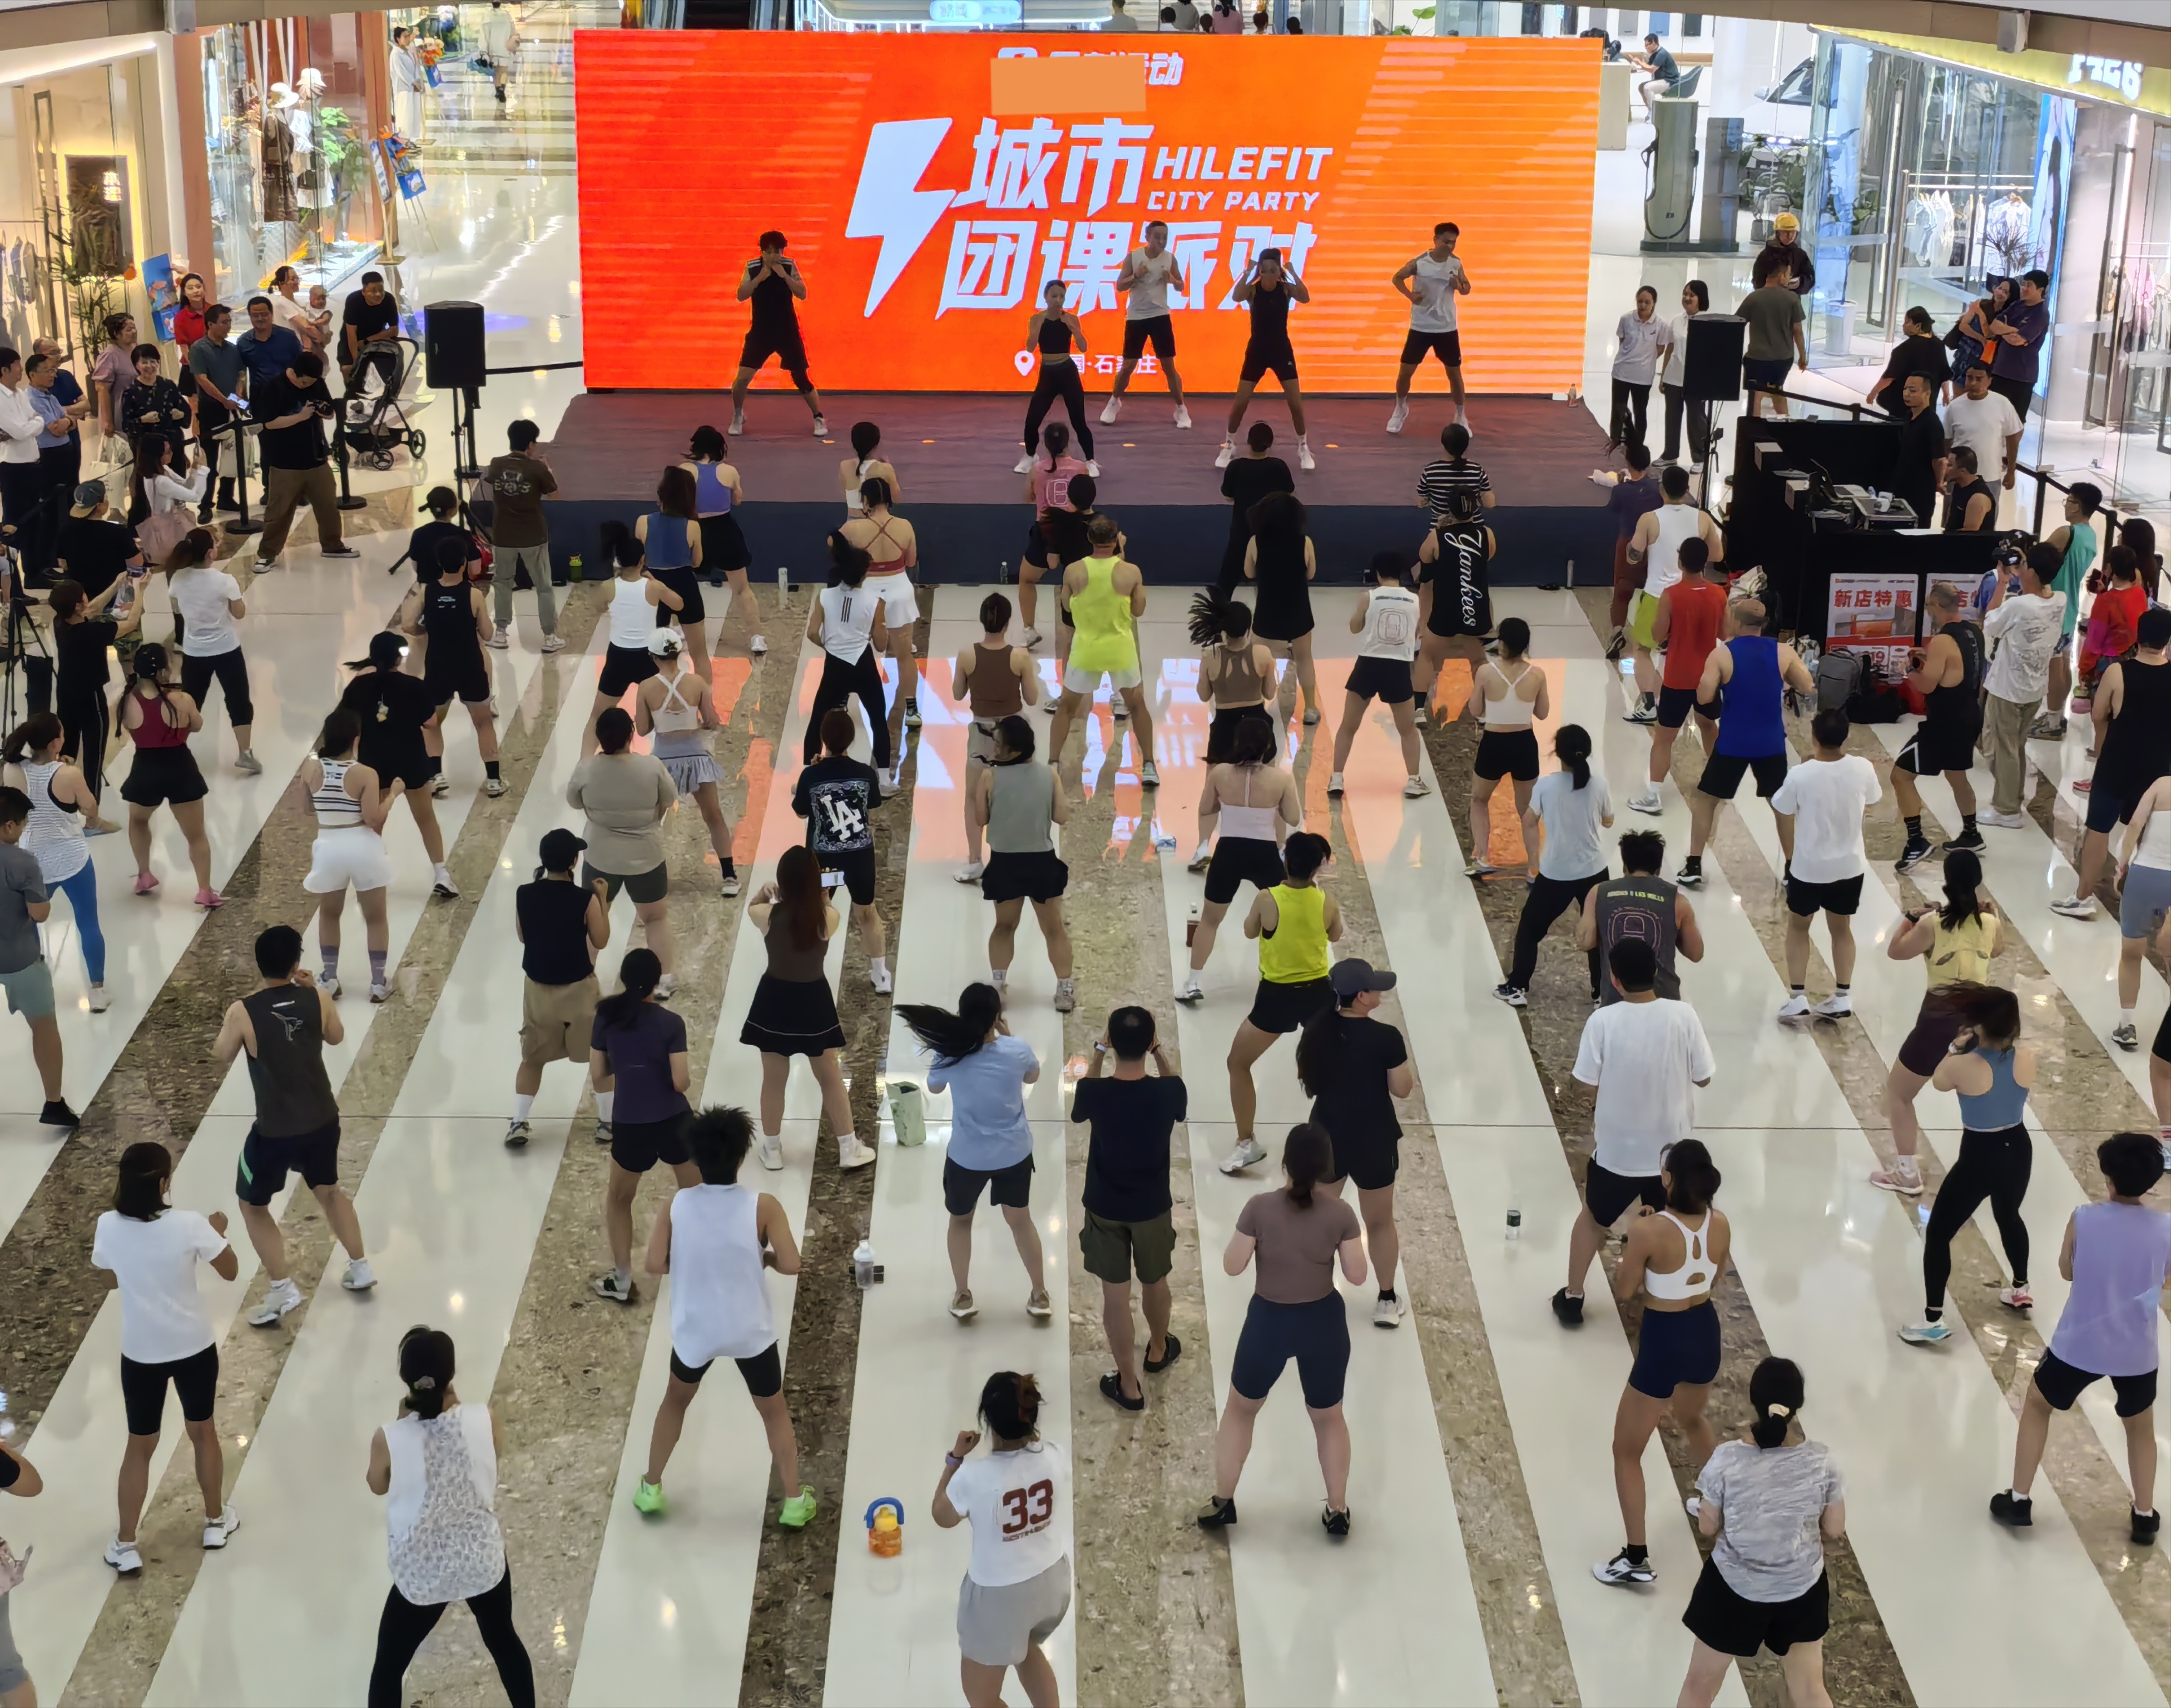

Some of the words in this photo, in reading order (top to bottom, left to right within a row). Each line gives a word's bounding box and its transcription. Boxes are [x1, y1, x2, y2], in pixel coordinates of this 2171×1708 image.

[950, 117, 1154, 217] 城市
[1152, 146, 1334, 181] HILEFIT
[1147, 191, 1214, 211] CITY
[1224, 191, 1320, 211] PARTY
[1444, 529, 1483, 627] Yankees
[1834, 588, 1912, 608] 新店特惠
[820, 794, 864, 841] LA
[1003, 1478, 1053, 1534] 33
